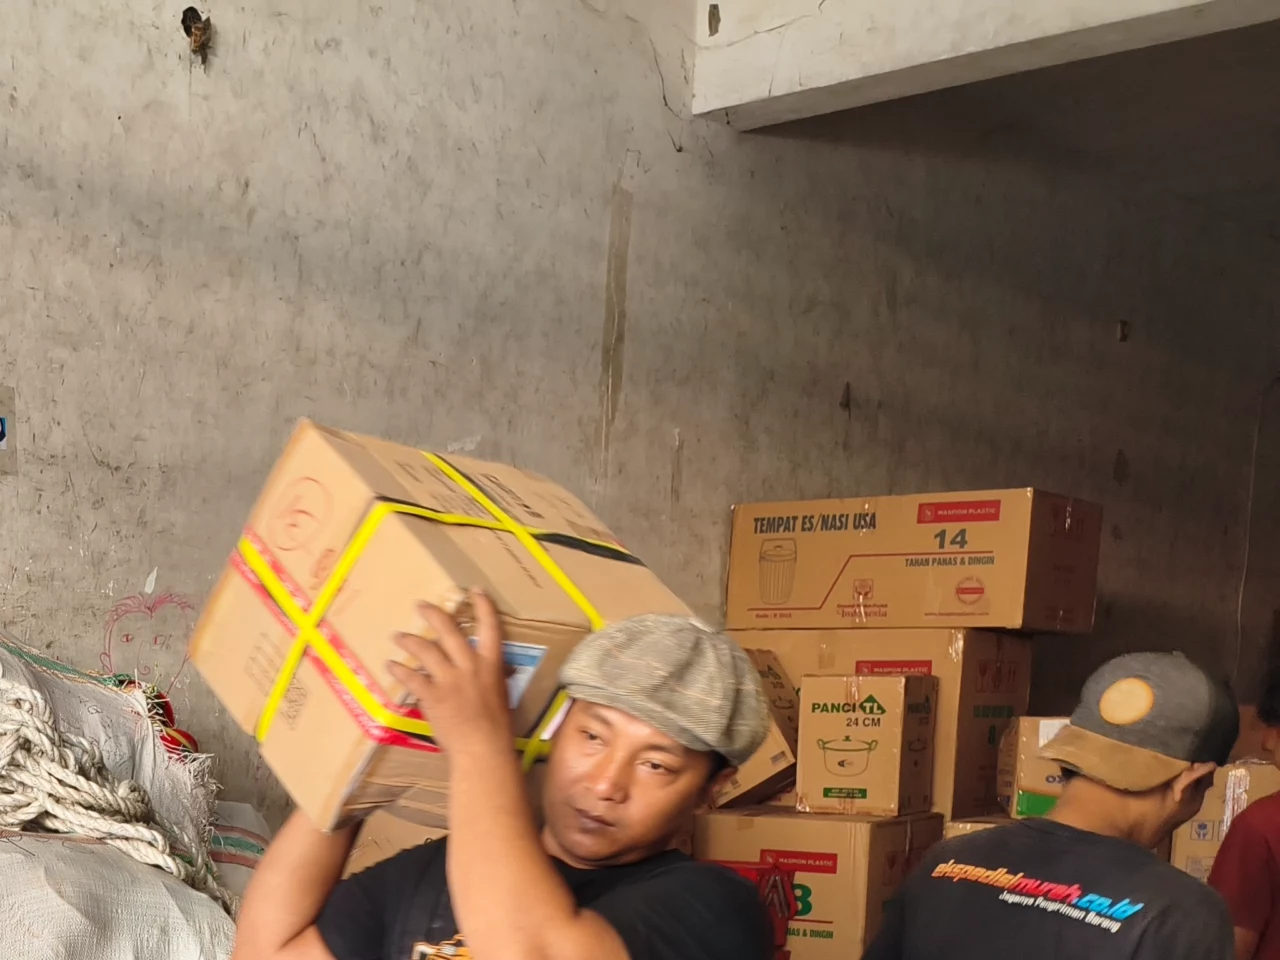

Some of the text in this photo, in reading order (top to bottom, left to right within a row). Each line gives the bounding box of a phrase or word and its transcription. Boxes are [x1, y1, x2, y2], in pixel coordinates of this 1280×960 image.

[937, 507, 996, 516] MASPION PLASTIC
[753, 511, 877, 535] TEMPAT ES/NASI USA
[933, 528, 968, 549] 14
[905, 555, 995, 567] TAHAN PANAS & DINGIN
[811, 702, 882, 715] PANCI TL
[845, 717, 881, 727] 24 CM
[778, 857, 834, 867] MASPION PLASTIC
[802, 928, 808, 938] &
[809, 929, 834, 939] DINGIN
